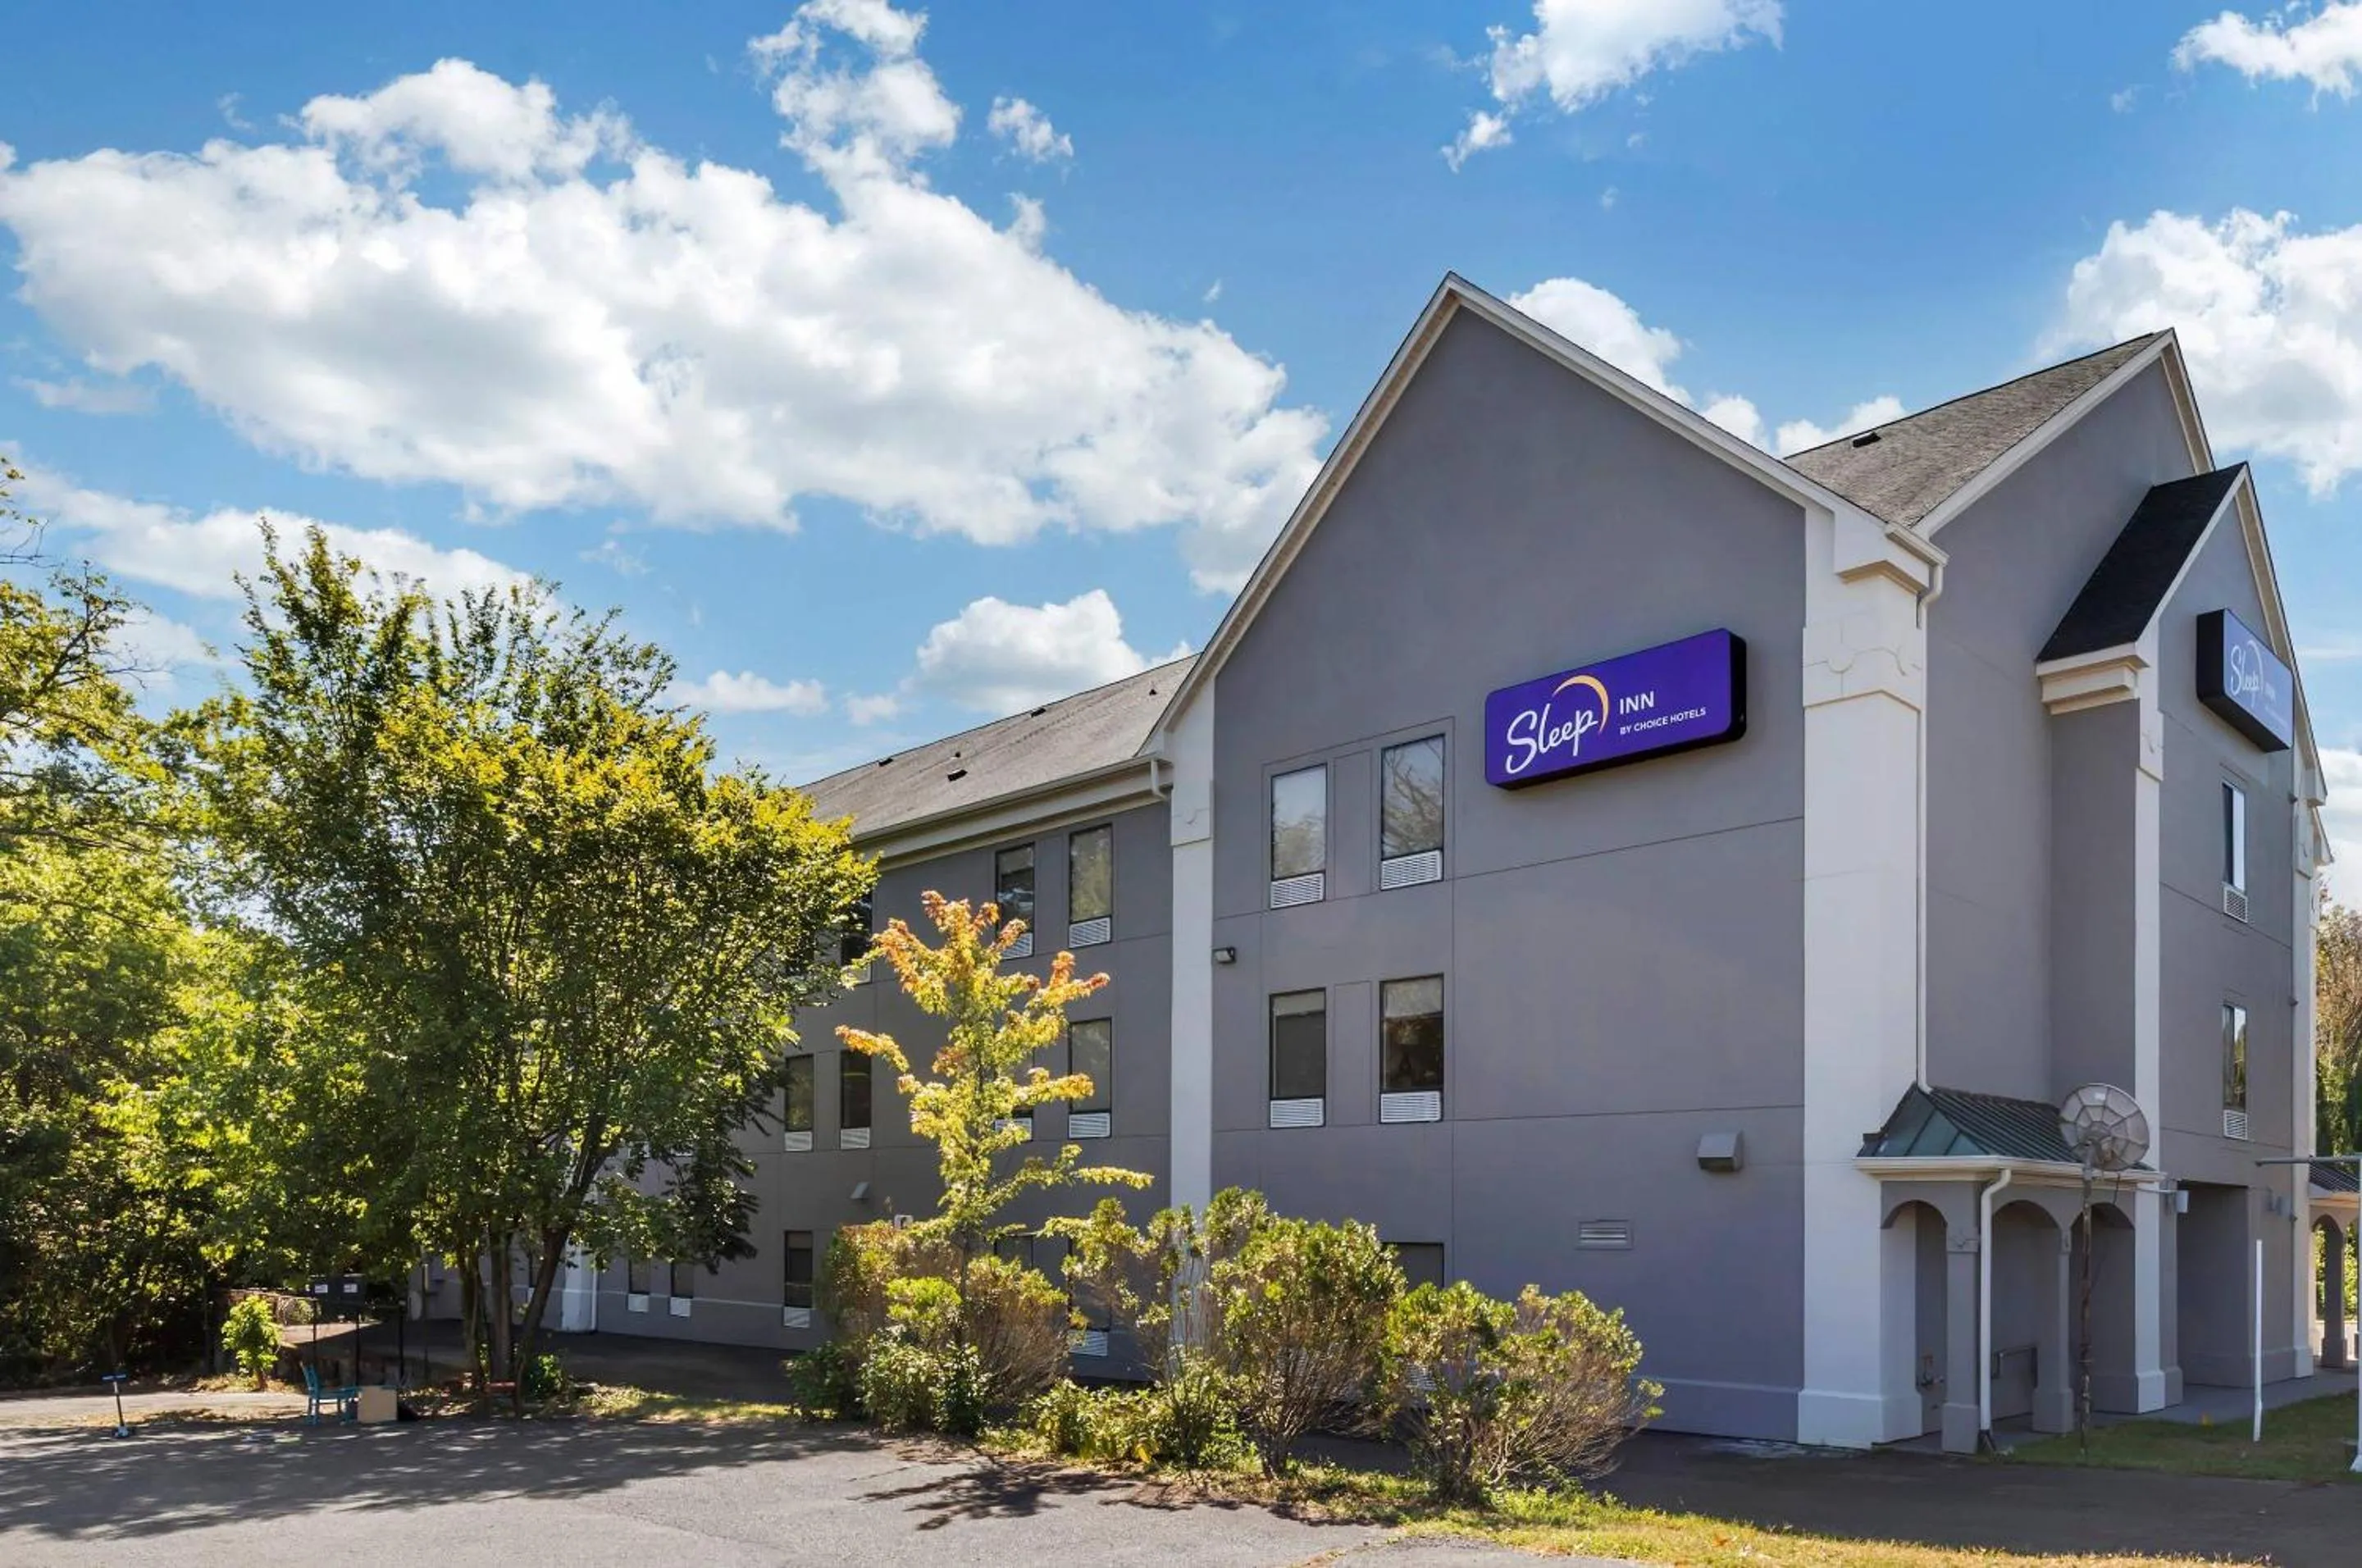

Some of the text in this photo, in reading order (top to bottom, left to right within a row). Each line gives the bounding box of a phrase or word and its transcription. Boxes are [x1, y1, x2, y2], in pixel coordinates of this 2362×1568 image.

[1506, 691, 1655, 774] Sleep INN
[1620, 707, 1707, 736] BY CHOICE HOTELS
